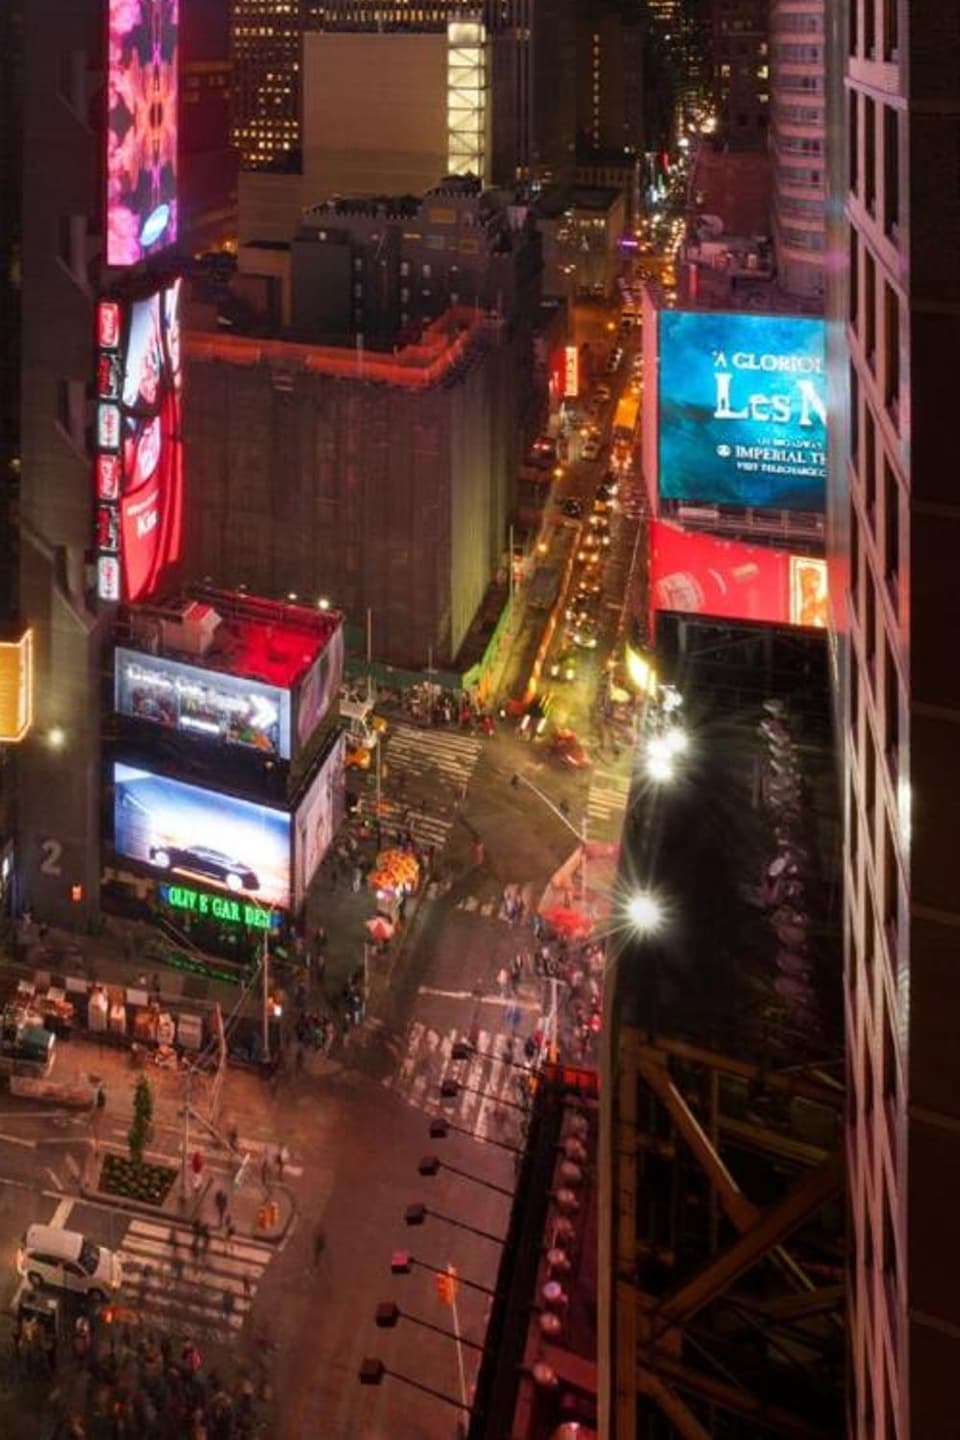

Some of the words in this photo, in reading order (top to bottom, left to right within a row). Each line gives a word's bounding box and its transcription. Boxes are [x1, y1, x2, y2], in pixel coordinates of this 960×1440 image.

[714, 372, 792, 423] Les
[735, 445, 807, 464] IMPERIAL
[41, 840, 62, 876] 2
